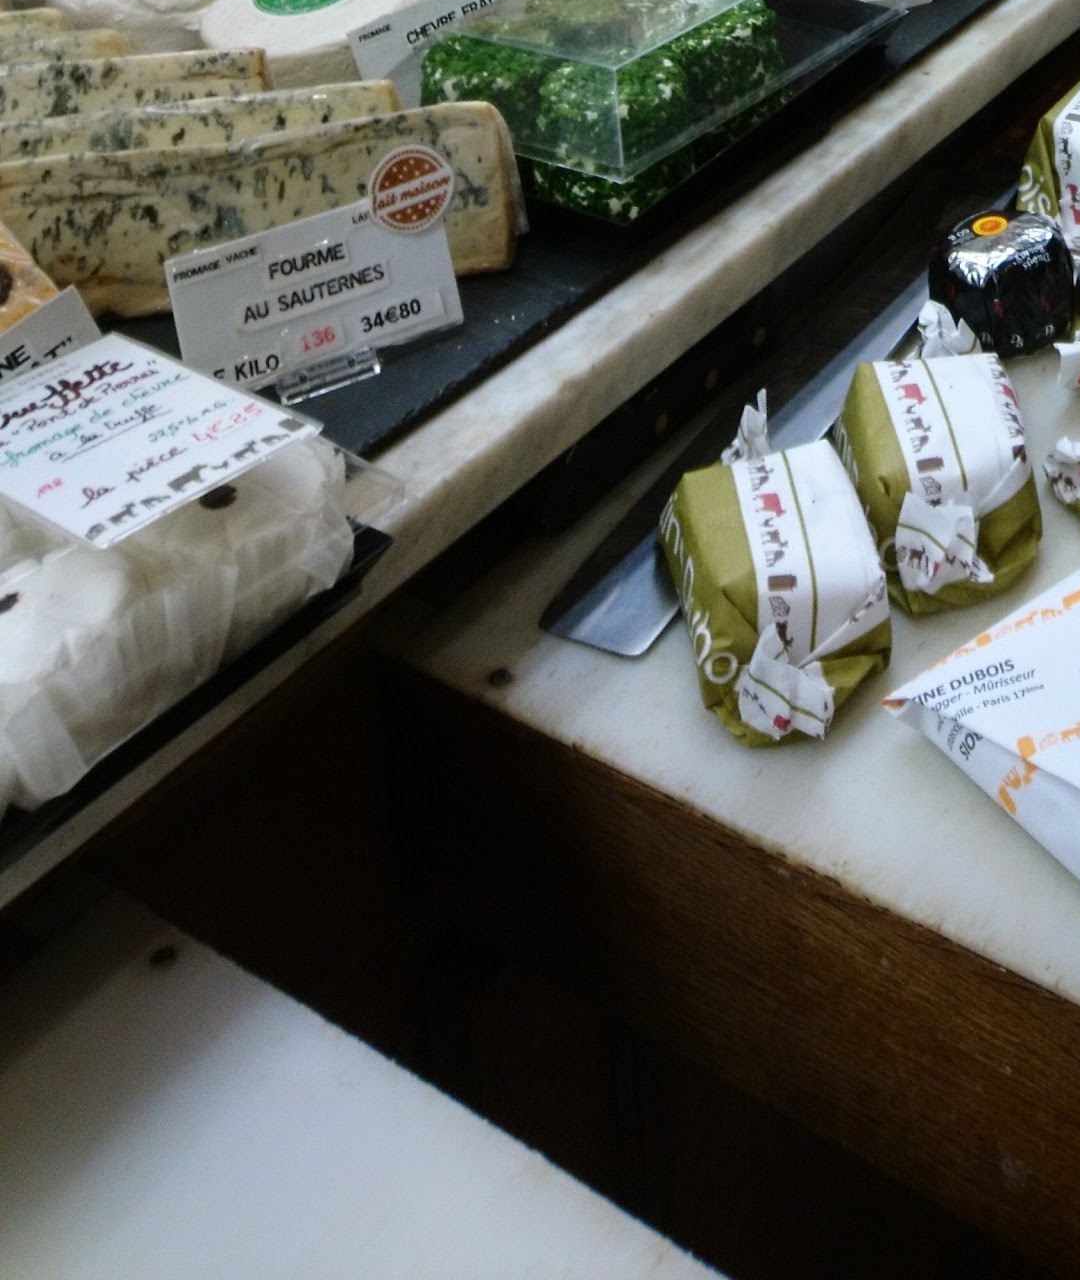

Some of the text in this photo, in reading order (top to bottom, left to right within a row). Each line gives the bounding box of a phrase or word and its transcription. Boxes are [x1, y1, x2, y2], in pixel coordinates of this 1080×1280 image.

[358, 23, 392, 43] FROMAGE
[400, 176, 451, 202] maison
[173, 246, 258, 282] FROMAGE VACHE
[268, 243, 346, 280] FOURME
[244, 263, 385, 324] AU SAUTERNES
[301, 298, 422, 353] 136 34€80
[234, 353, 280, 382] KILO
[80, 445, 189, 510] la pièce
[948, 659, 1015, 691] DUBOIS
[972, 668, 1037, 695] Mûrisseur
[982, 696, 1009, 715] Paris
